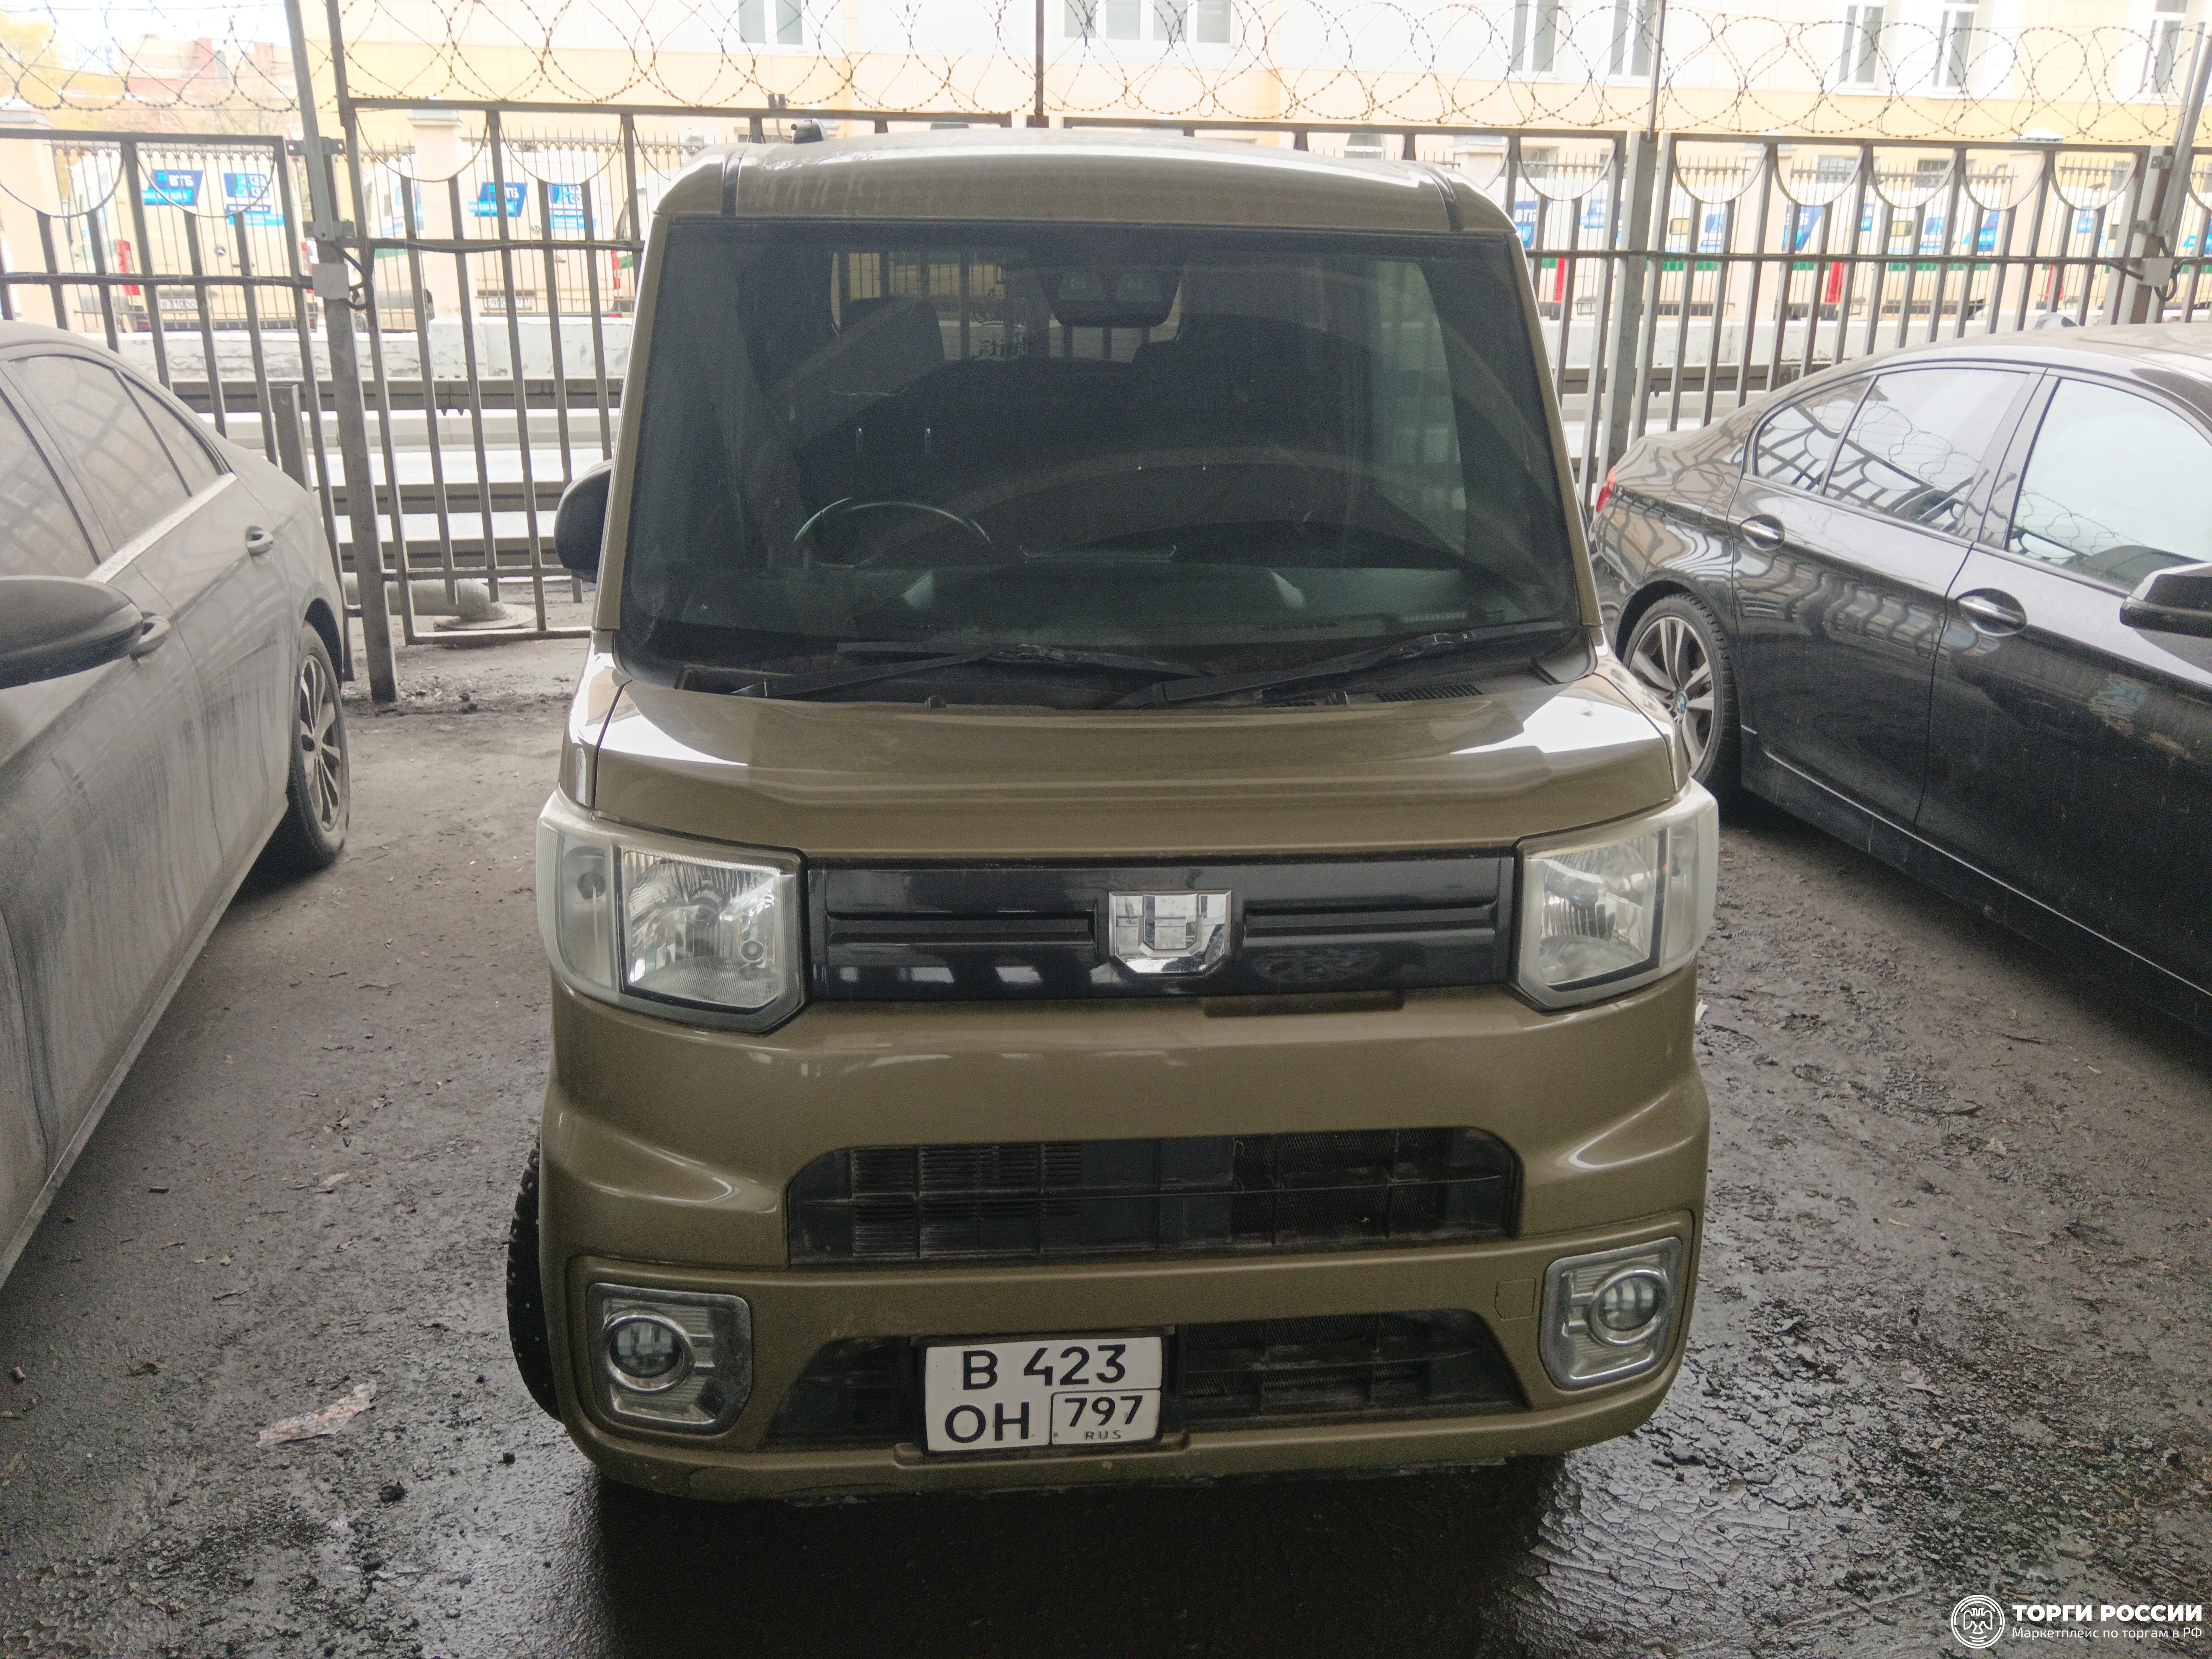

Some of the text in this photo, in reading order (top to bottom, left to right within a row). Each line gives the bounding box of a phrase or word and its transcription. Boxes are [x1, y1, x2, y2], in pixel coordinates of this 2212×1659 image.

[168, 175, 194, 186] ВТБ
[963, 1344, 1126, 1390] В 423
[945, 1395, 1143, 1443] ОН 797
[1085, 1429, 1122, 1440] RUS
